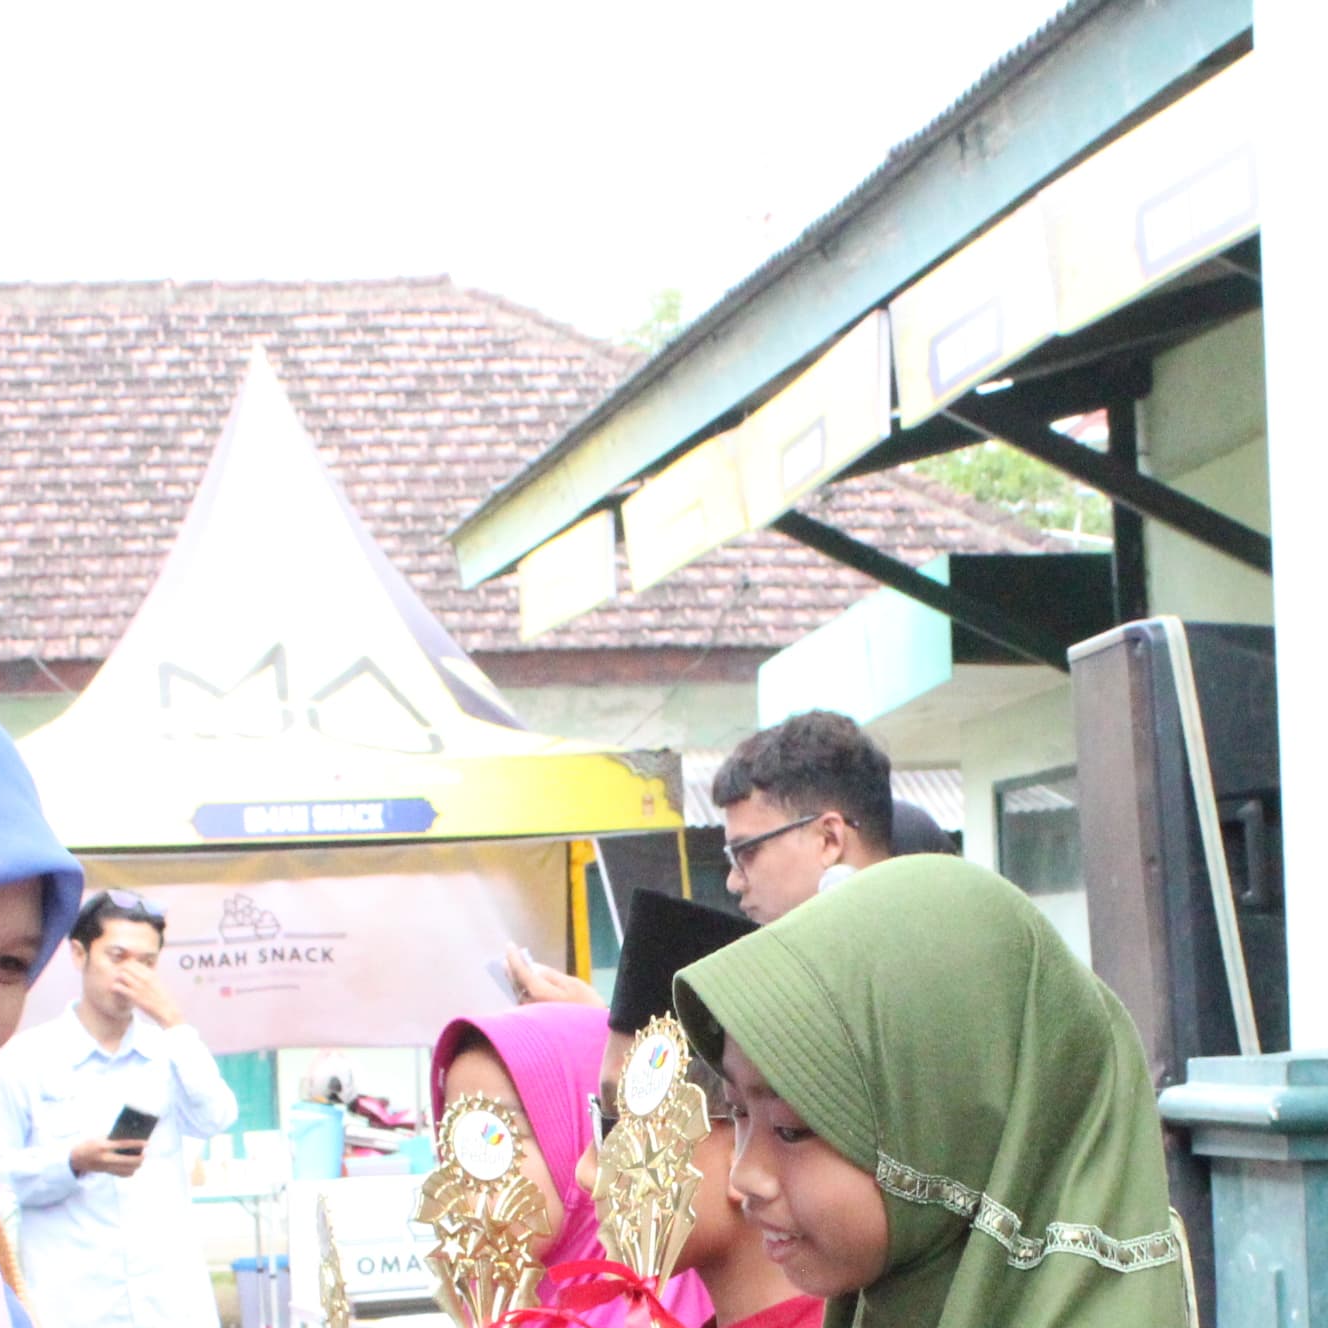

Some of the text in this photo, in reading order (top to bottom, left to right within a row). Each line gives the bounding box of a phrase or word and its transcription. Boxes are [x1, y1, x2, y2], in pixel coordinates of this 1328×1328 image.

[179, 947, 335, 969] OMAH SNACK
[356, 1253, 423, 1276] OMA
